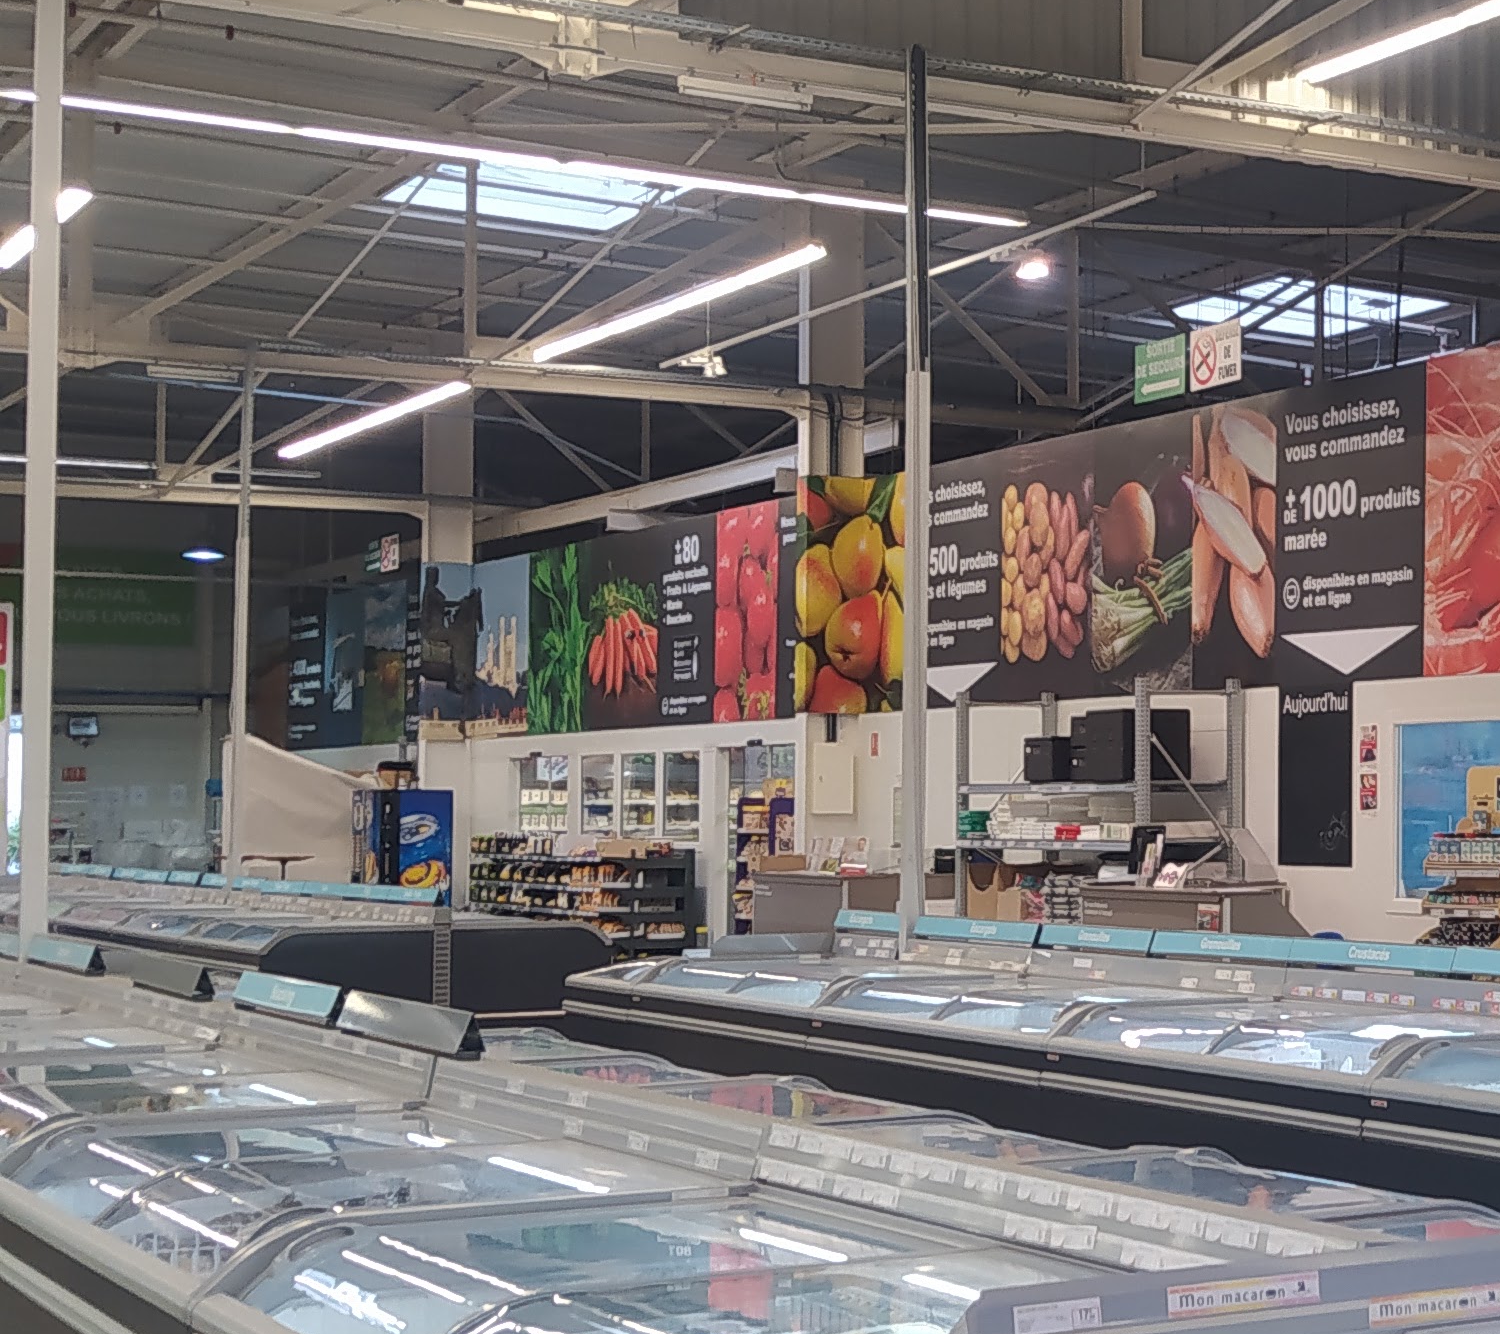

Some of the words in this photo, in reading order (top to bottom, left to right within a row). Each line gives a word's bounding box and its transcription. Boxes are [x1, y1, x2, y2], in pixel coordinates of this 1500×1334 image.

[1285, 413, 1319, 434] Vous
[1322, 399, 1400, 428] choisissez,
[1285, 443, 1317, 462] vous
[1320, 425, 1405, 457] commandez
[935, 480, 986, 503] choisissez,
[1284, 509, 1297, 525] DE
[1300, 479, 1357, 521] 1000
[1361, 485, 1421, 518] produits
[934, 501, 989, 526] commandez
[682, 534, 700, 565] 80
[1284, 528, 1327, 552] marée
[929, 543, 958, 577] 500
[960, 551, 999, 577] produits
[936, 581, 946, 599] et
[948, 579, 987, 601] légumes
[1303, 572, 1355, 592] disponibles
[1357, 573, 1370, 586] en
[1371, 566, 1414, 586] magasin
[1303, 595, 1313, 608] et
[1315, 594, 1327, 607] en
[1328, 591, 1352, 609] ligne
[1282, 690, 1348, 719] Aujourd'hui
[1349, 946, 1391, 961] Crustacés
